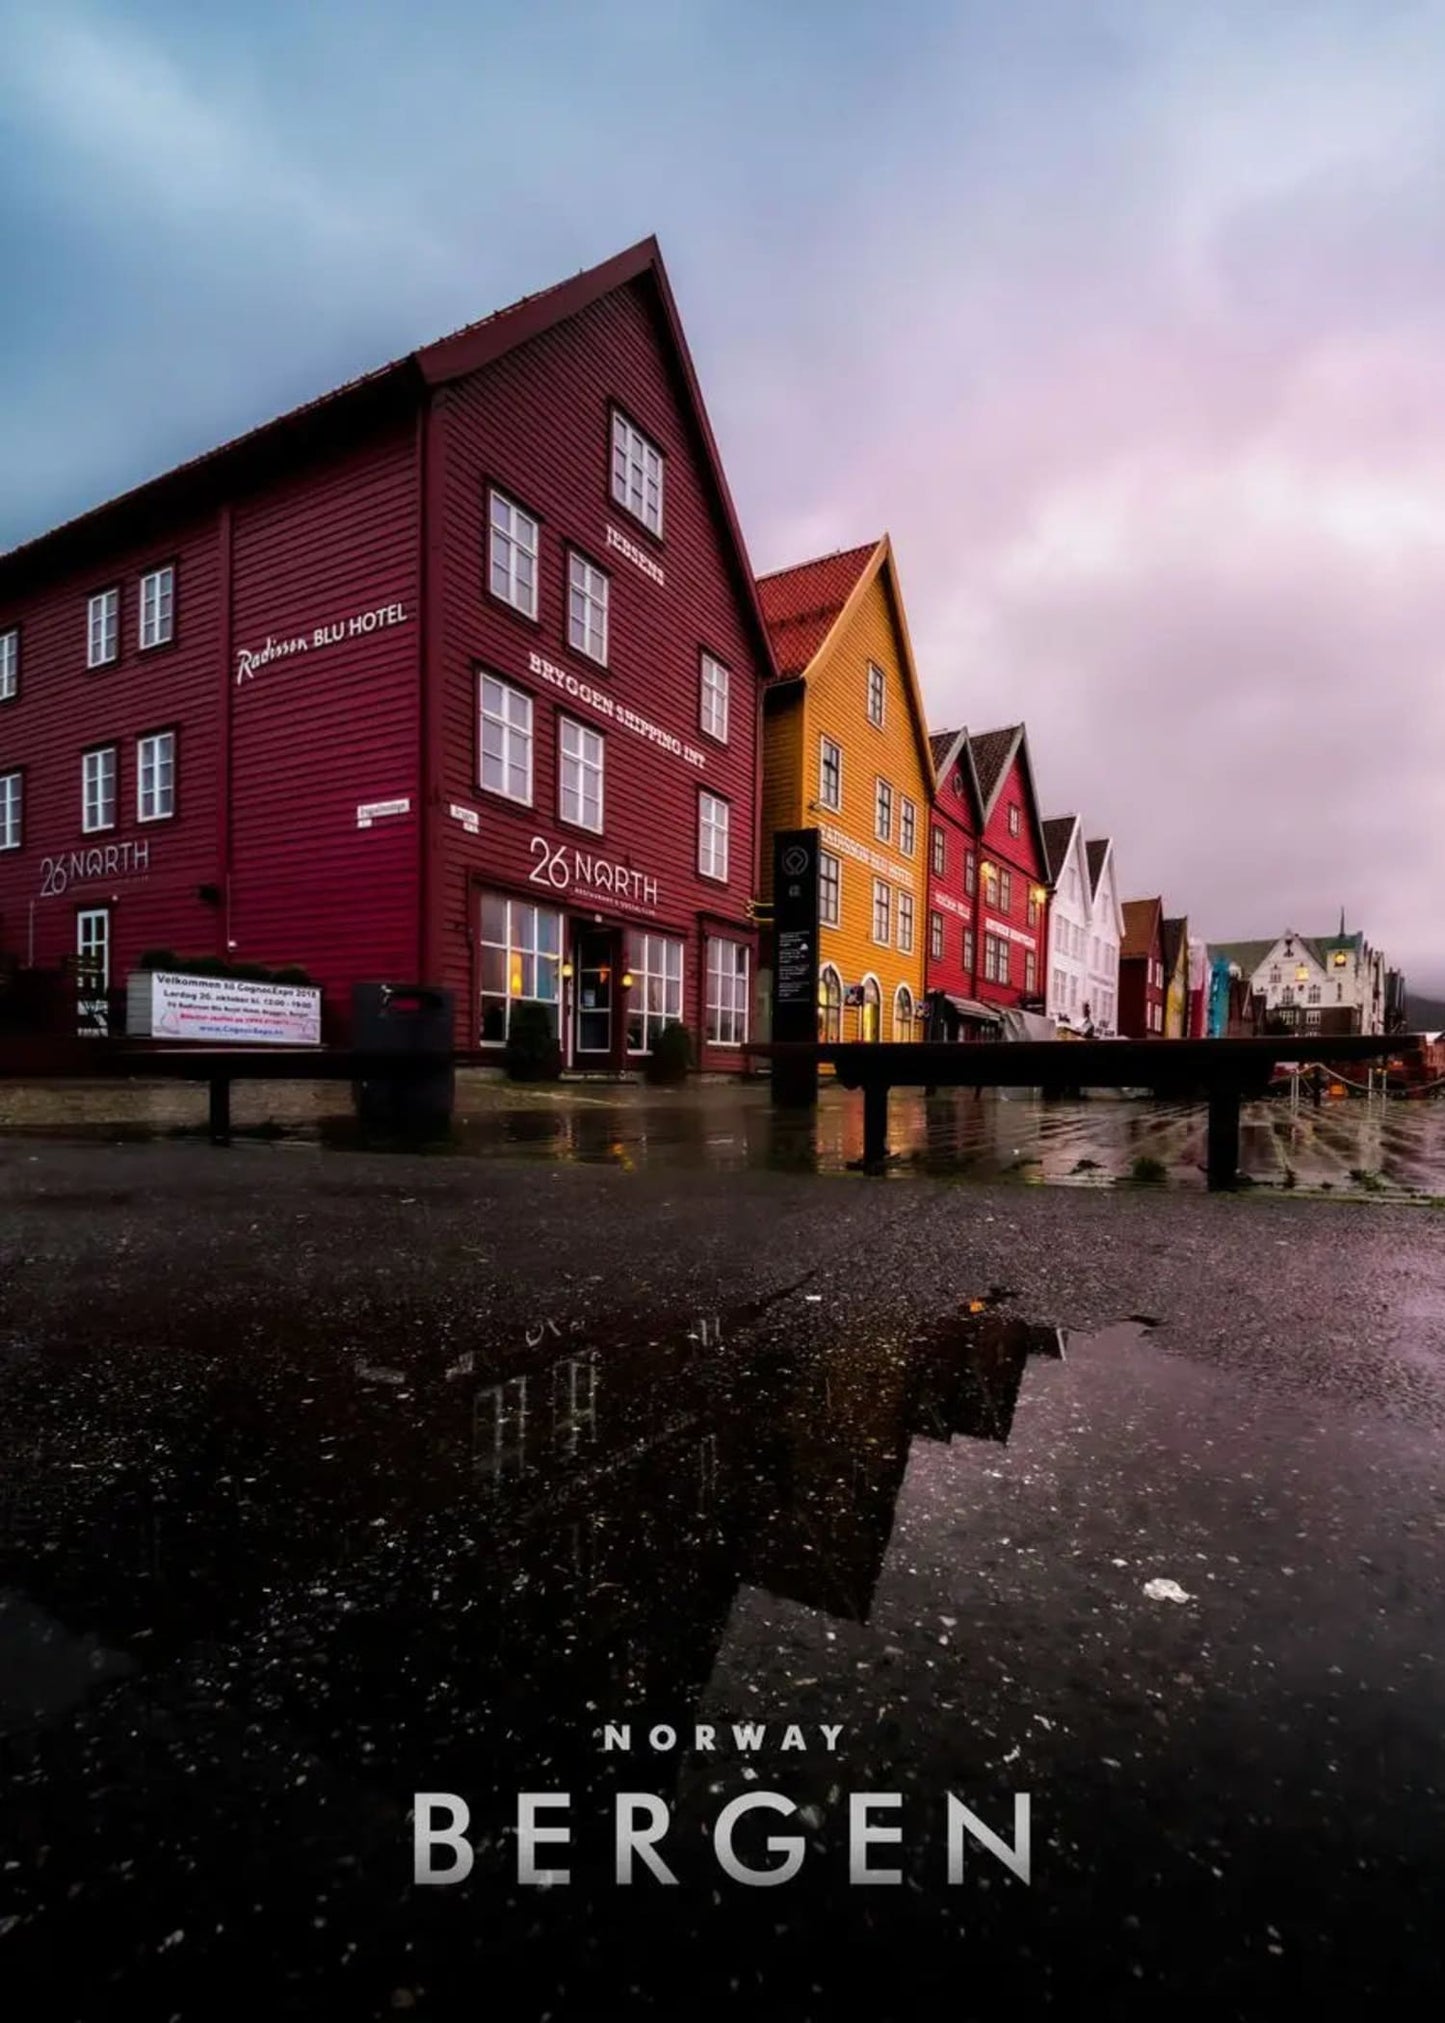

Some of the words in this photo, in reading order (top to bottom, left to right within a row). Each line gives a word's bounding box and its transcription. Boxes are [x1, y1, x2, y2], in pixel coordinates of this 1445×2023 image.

[236, 635, 308, 685] Radisson
[313, 621, 345, 647] BLU
[349, 602, 408, 637] HOTEL
[529, 651, 615, 718] BRYGGEN
[614, 703, 682, 756] SHIPPING
[40, 854, 67, 897] 26
[70, 839, 149, 879] NORTH
[529, 836, 569, 889] 26
[575, 850, 658, 906] NORTH
[156, 973, 222, 990] Velkommen
[295, 988, 317, 998] 2018
